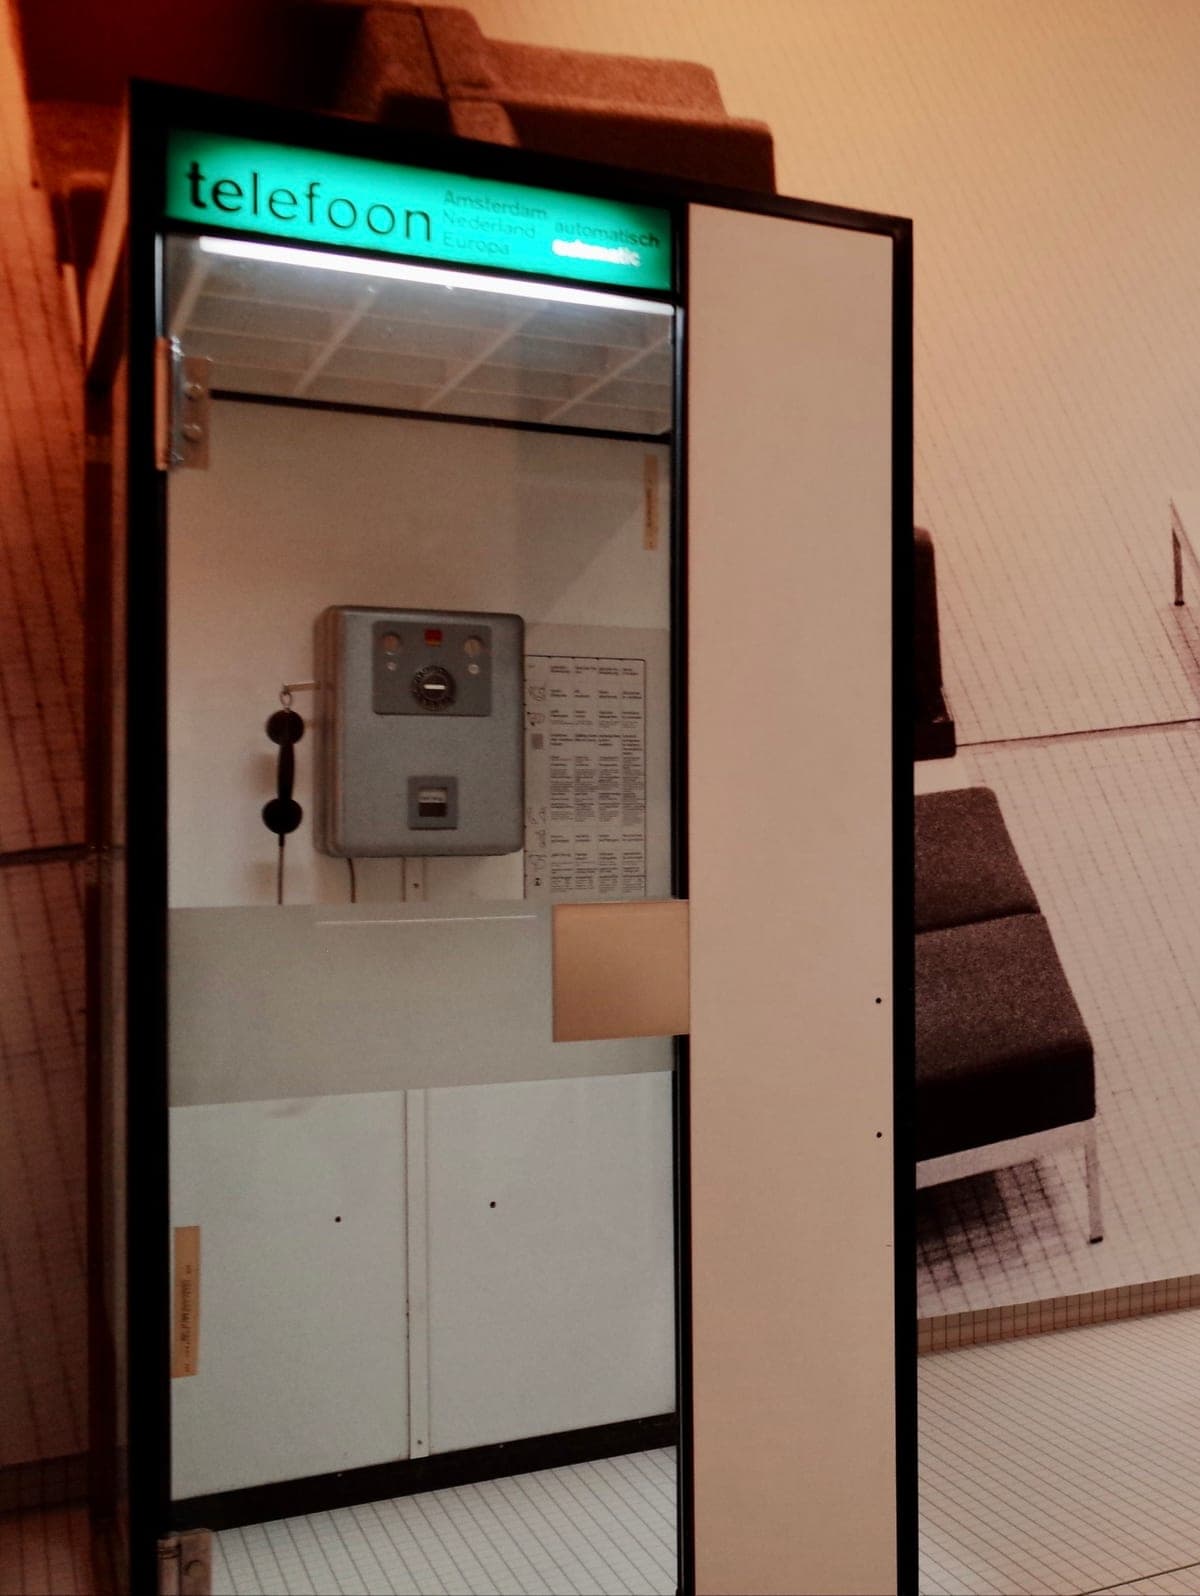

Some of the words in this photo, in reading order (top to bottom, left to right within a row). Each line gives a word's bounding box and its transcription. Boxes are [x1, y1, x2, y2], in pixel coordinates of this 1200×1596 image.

[185, 161, 431, 241] telefoon
[443, 190, 547, 219] Amsterdam
[443, 211, 536, 239] Nederland
[555, 219, 660, 247] automatisch
[443, 230, 510, 256] Europa
